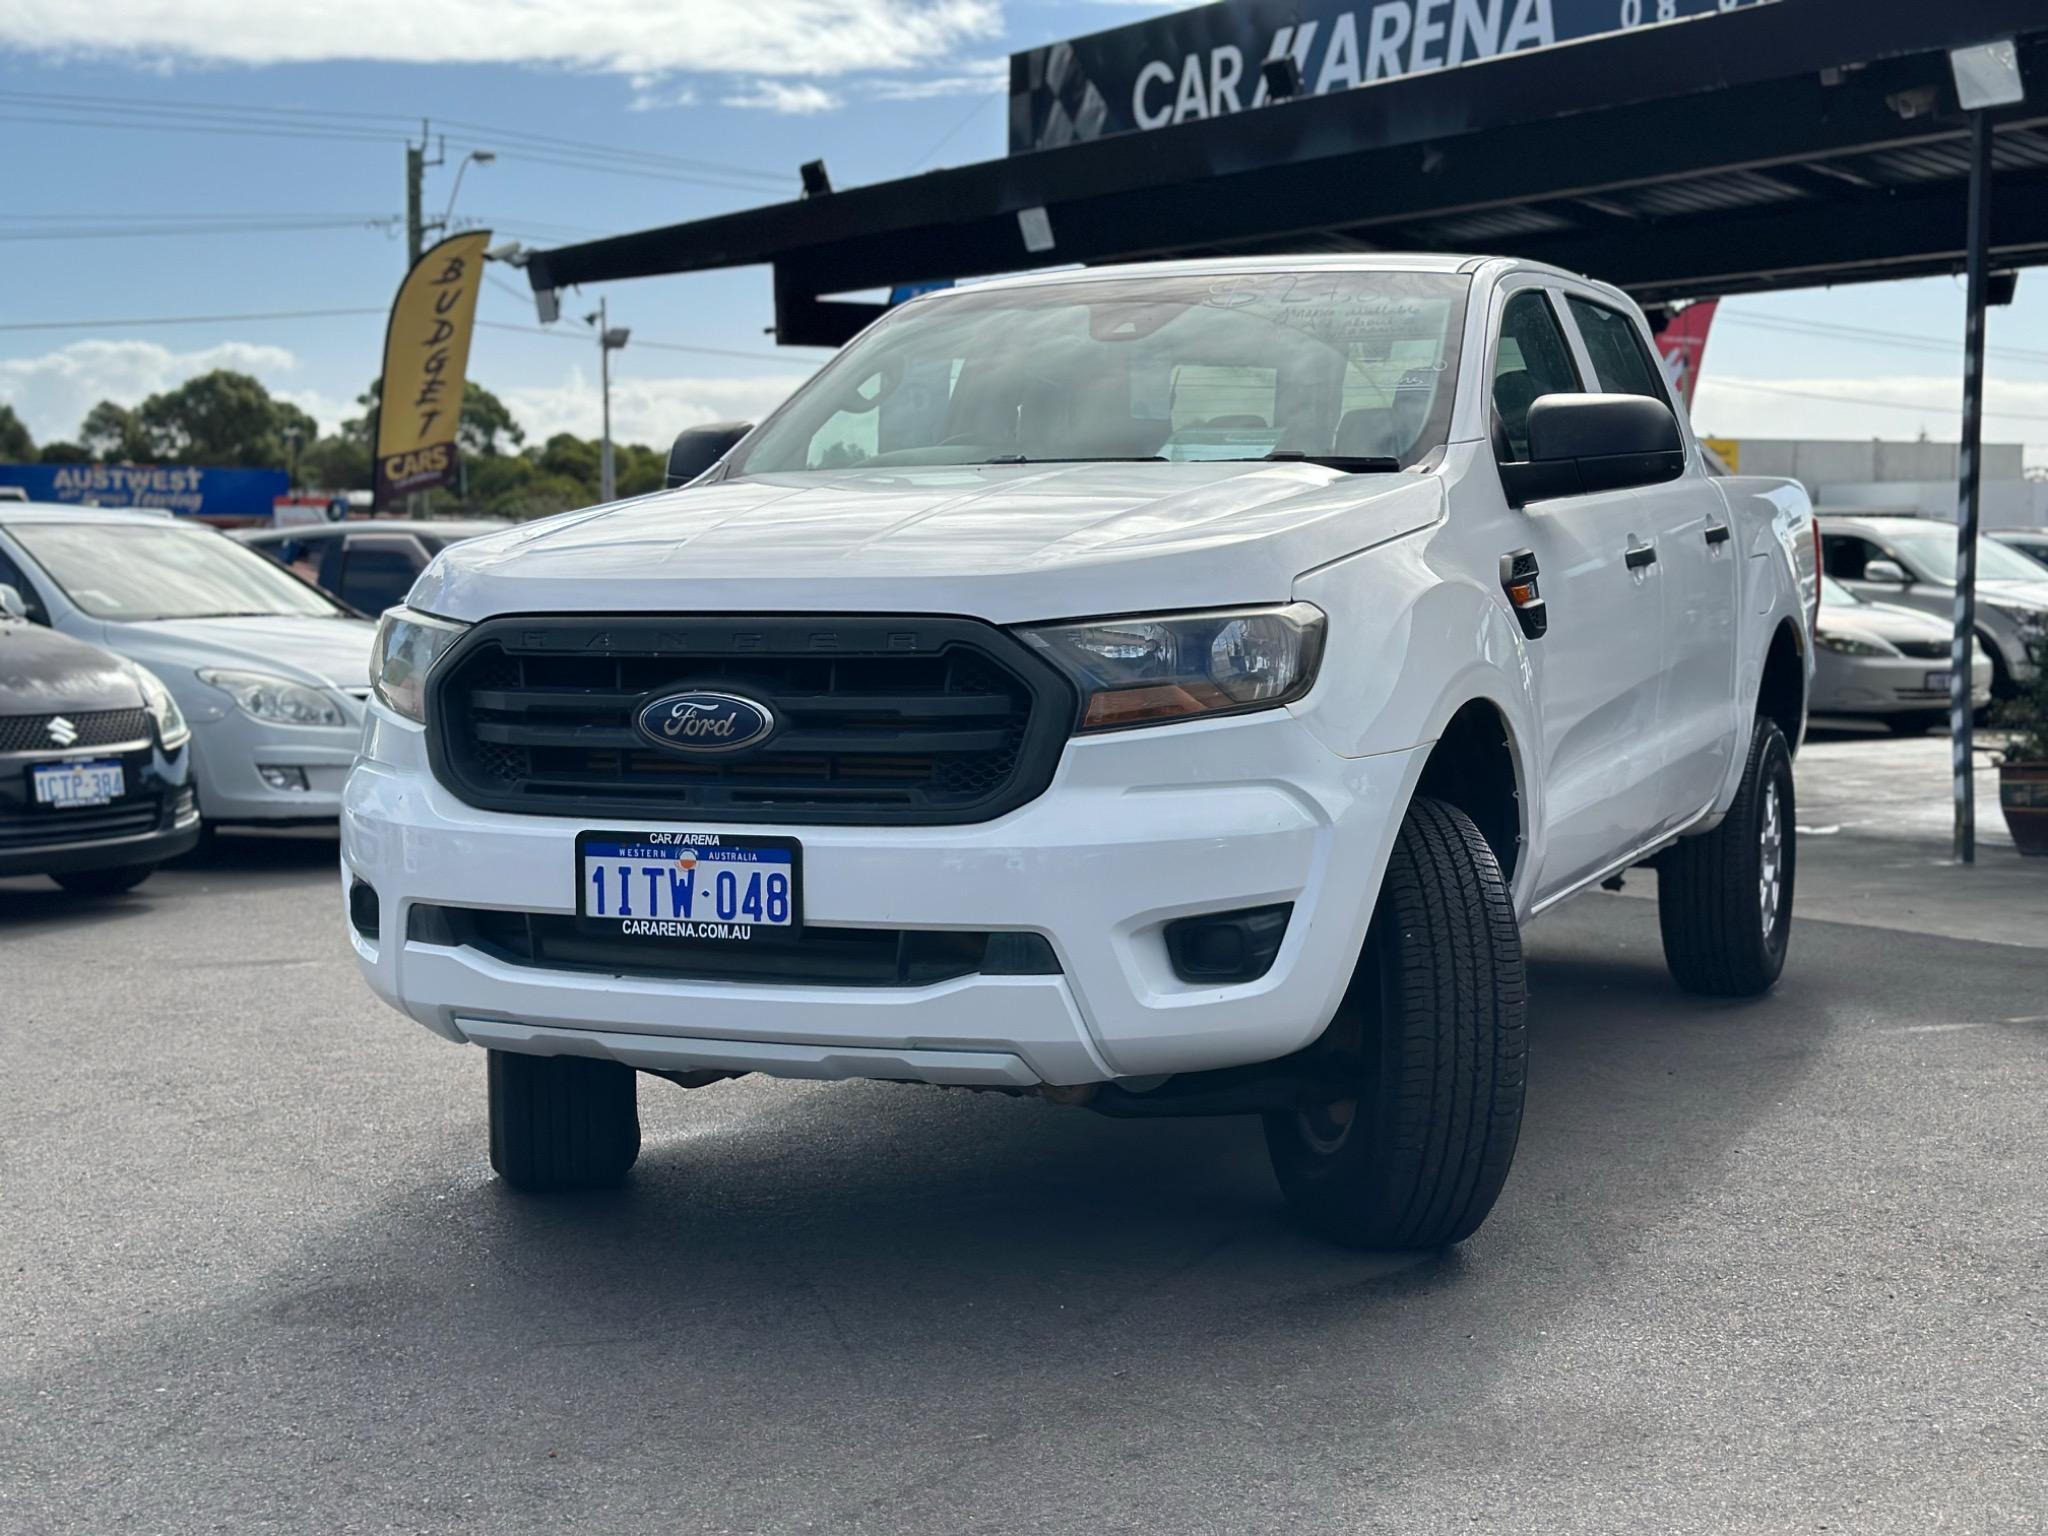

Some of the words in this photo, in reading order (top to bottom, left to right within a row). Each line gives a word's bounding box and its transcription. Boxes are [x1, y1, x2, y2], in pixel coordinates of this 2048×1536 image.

[1132, 45, 1243, 131] CAR
[1313, 0, 1556, 96] ARENA
[417, 255, 466, 440] BUDGET
[385, 446, 448, 480] CARS
[53, 467, 203, 491] AUSTWEST
[520, 631, 920, 650] RANGER
[664, 702, 737, 736] Ford
[649, 833, 672, 845] CAR
[683, 834, 720, 846] ARENA
[619, 848, 666, 859] WESTERN
[708, 851, 758, 862] AUSTRALIA
[622, 919, 751, 940] CARARENA.COM.AU
